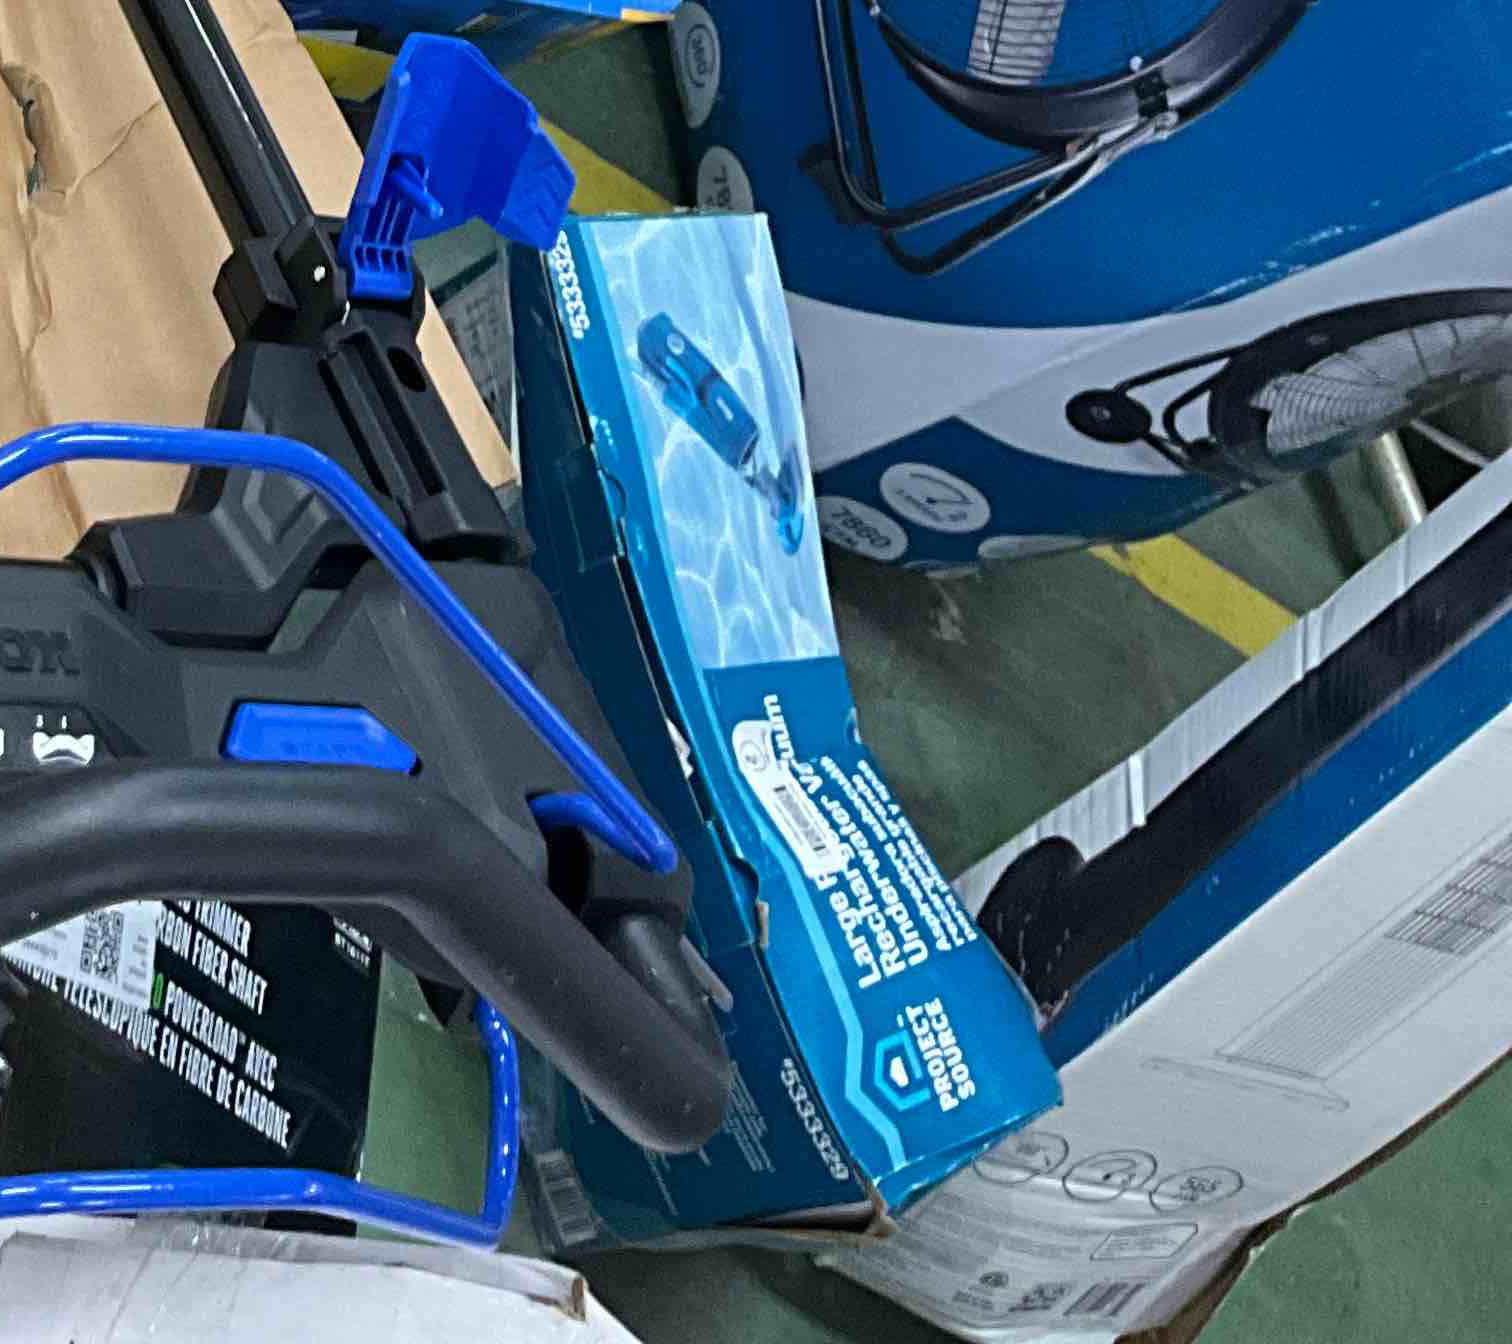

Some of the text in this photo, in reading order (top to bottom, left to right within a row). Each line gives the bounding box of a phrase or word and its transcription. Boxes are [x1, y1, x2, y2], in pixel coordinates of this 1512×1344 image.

[819, 794, 928, 967] Underwater
[884, 842, 952, 951] Aspiradora
[943, 894, 978, 942] para
[191, 930, 228, 988] FIBER
[229, 959, 267, 1016] SHAFT
[829, 890, 882, 989] Large
[159, 1021, 180, 1072] EN
[178, 1040, 218, 1098] FIBRE
[215, 1062, 236, 1111] DE
[235, 1078, 291, 1151] CARBONE
[245, 1038, 278, 1093] AVEC
[905, 1004, 959, 1113] PROJECT
[923, 996, 976, 1101] SOURCE
